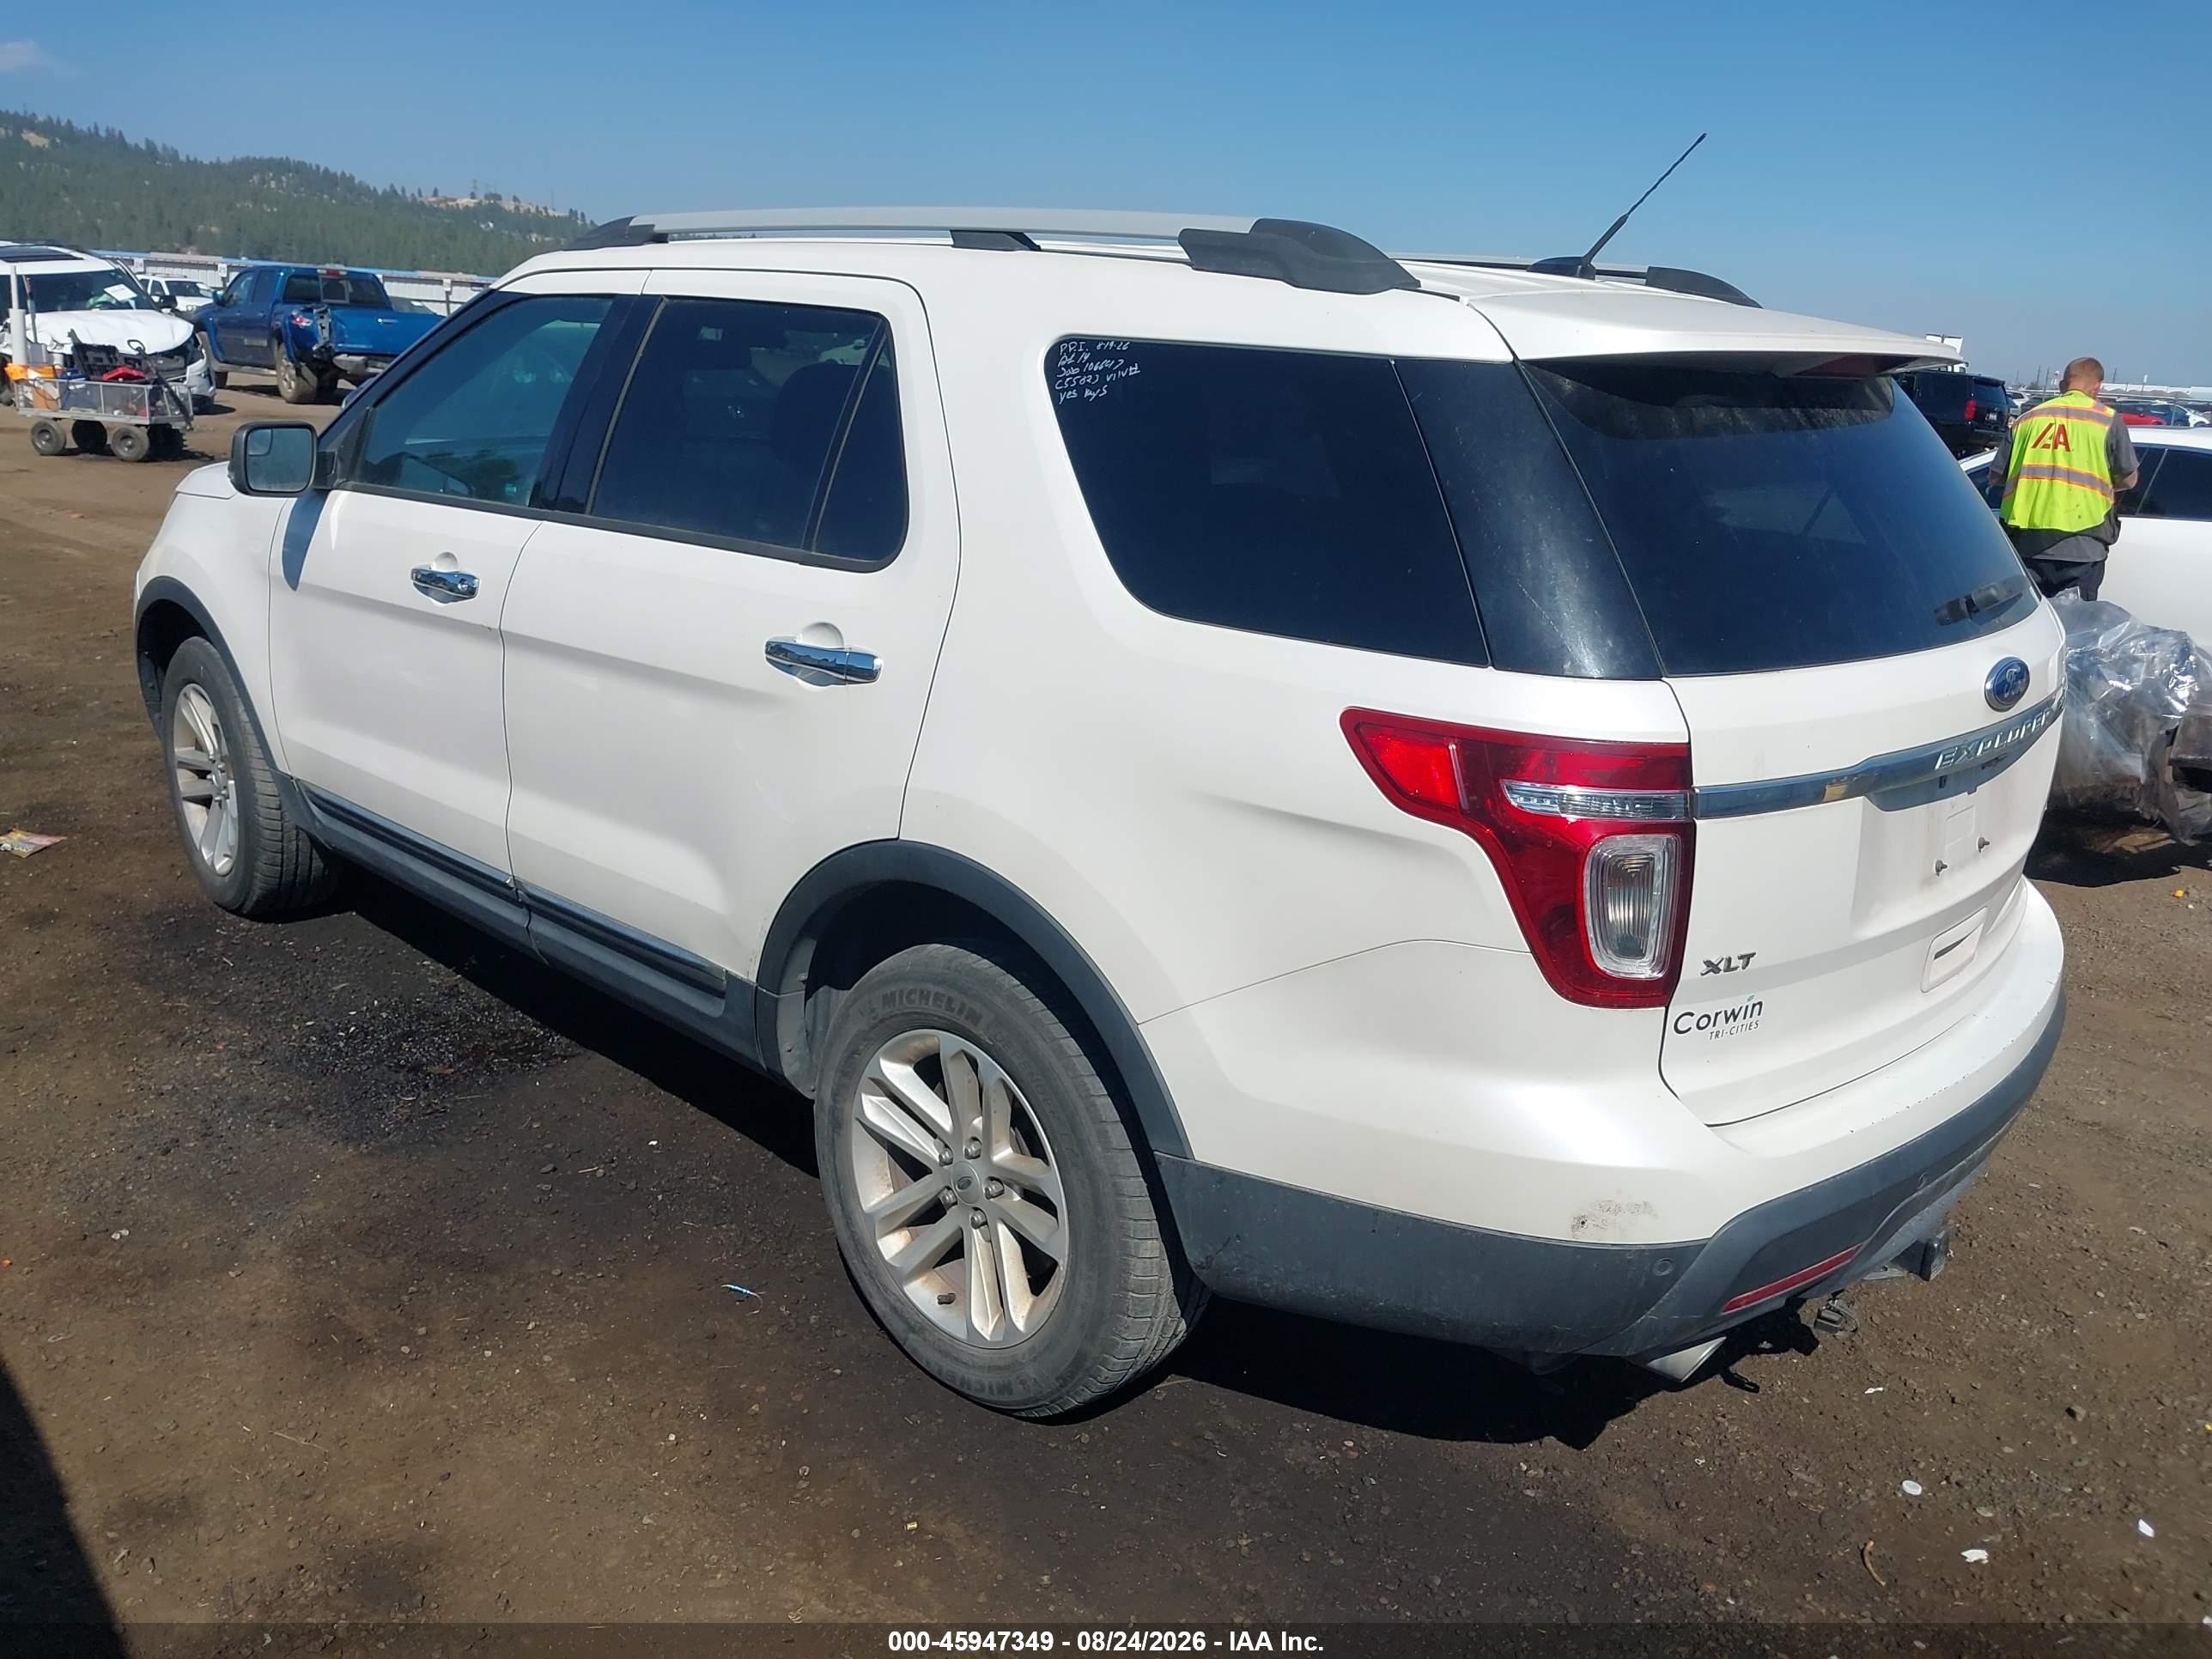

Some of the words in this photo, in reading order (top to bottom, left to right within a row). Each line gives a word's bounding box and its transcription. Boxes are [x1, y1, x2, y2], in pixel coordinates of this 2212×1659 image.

[1700, 951, 1757, 976] XLT
[881, 988, 984, 1026] MICHELIN
[1673, 994, 1763, 1035] Corwin
[1709, 1019, 1759, 1041] TRI-CITIES
